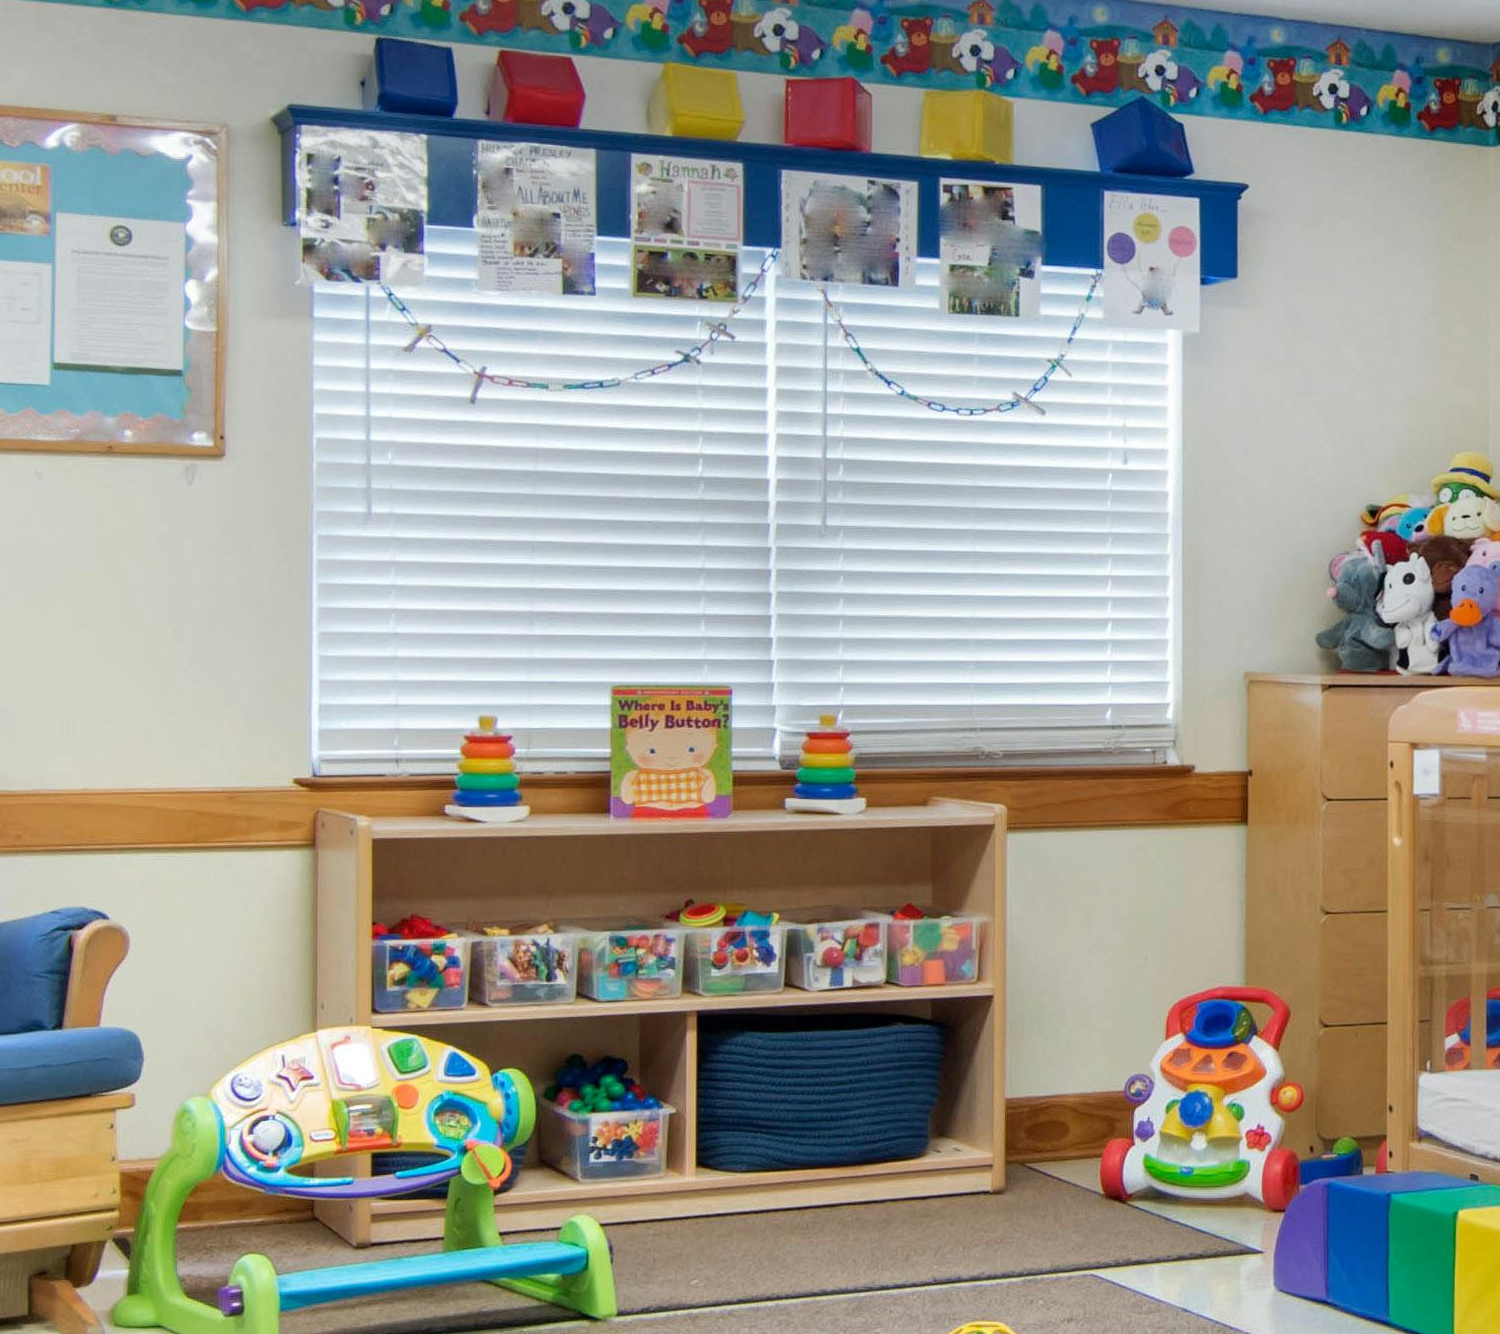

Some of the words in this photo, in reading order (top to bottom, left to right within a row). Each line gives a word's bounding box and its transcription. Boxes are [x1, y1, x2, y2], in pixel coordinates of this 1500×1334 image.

[660, 160, 721, 180] Hannah
[617, 700, 665, 711] Where
[670, 700, 682, 711] Is
[685, 700, 730, 713] Baby's
[617, 713, 659, 732] Belly
[664, 714, 729, 729] Button?
